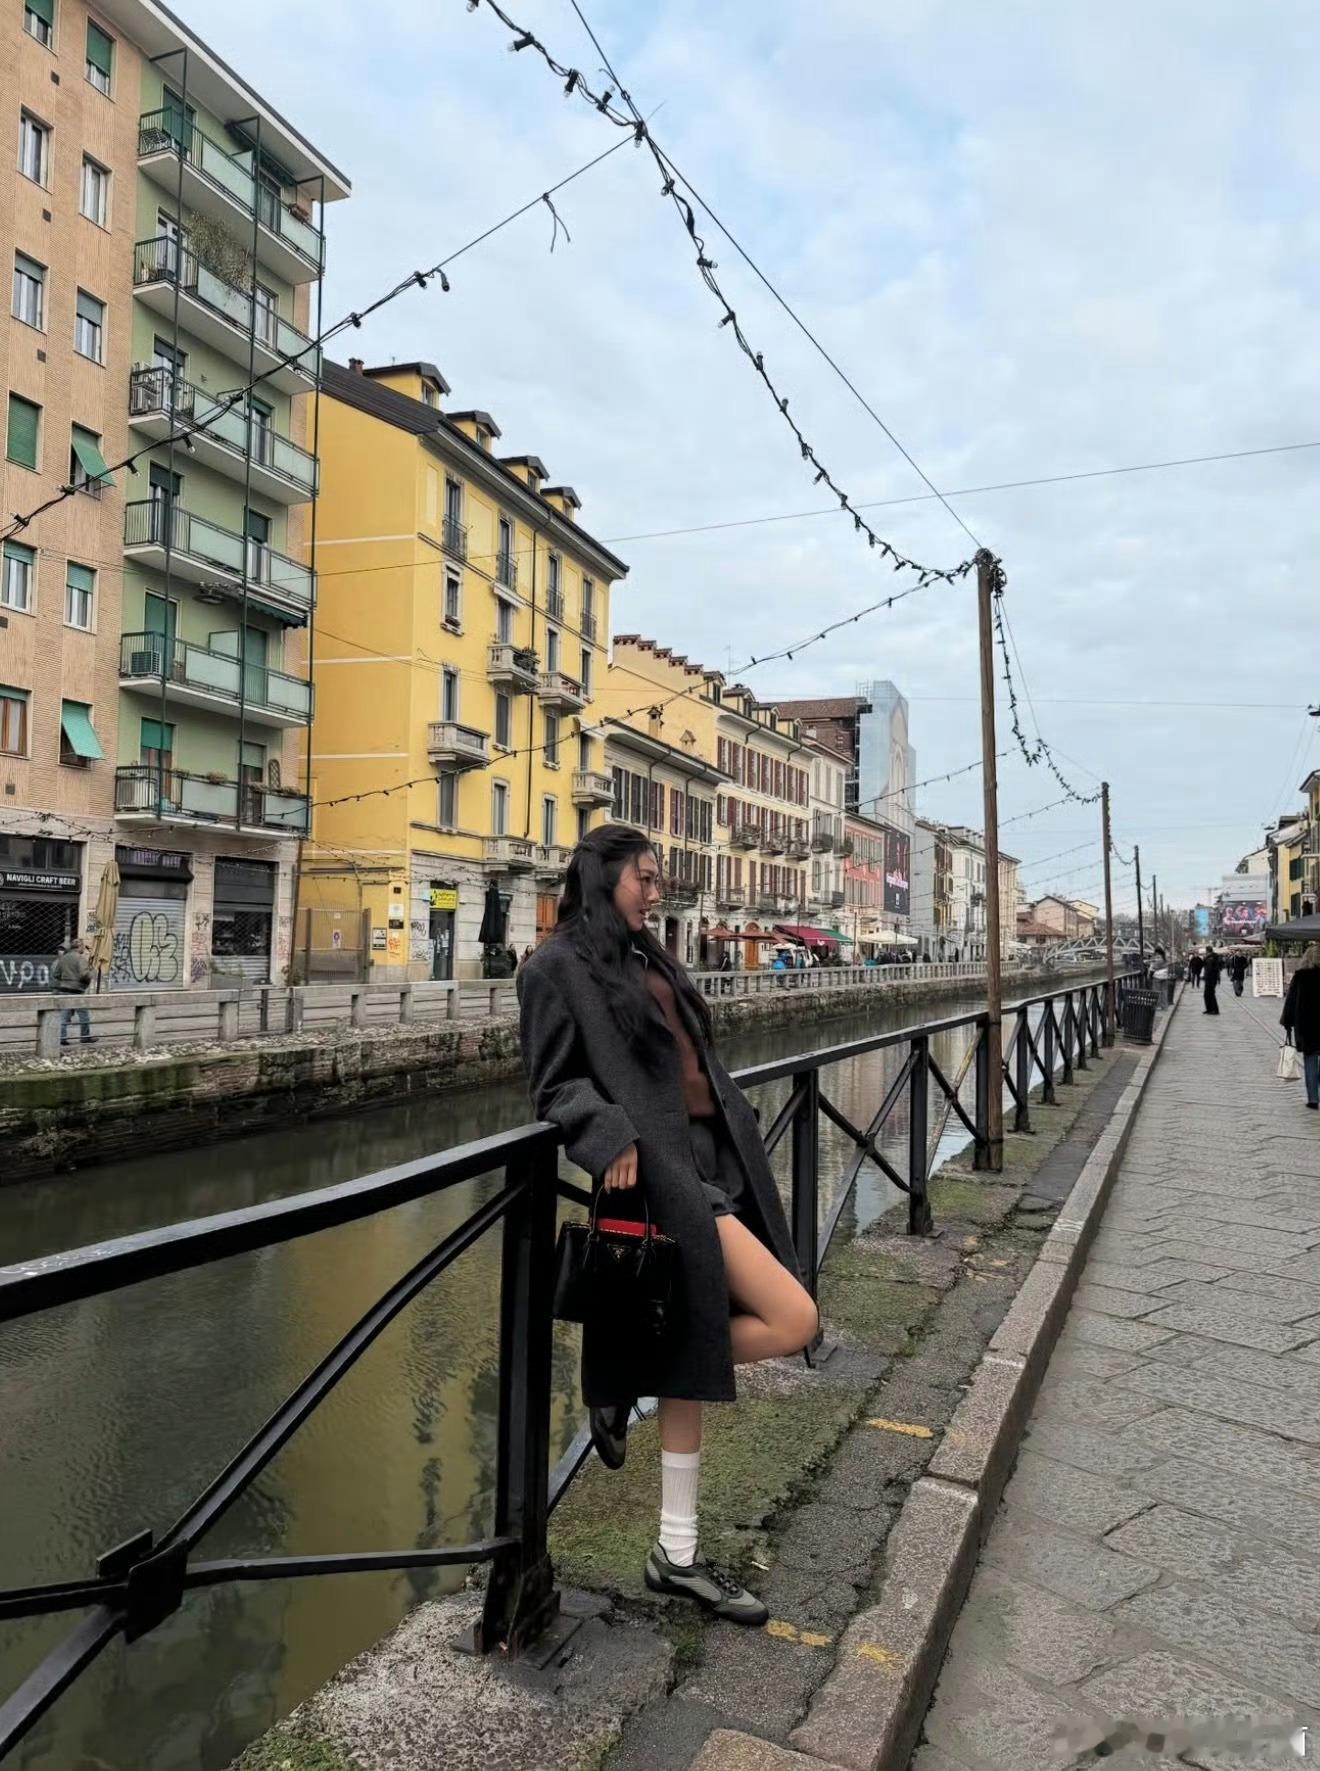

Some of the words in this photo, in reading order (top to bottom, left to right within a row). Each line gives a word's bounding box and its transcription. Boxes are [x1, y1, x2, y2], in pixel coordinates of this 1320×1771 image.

[6, 873, 35, 883] NAVIGLI
[36, 875, 57, 885] CRAFT
[58, 877, 76, 886] BEER
